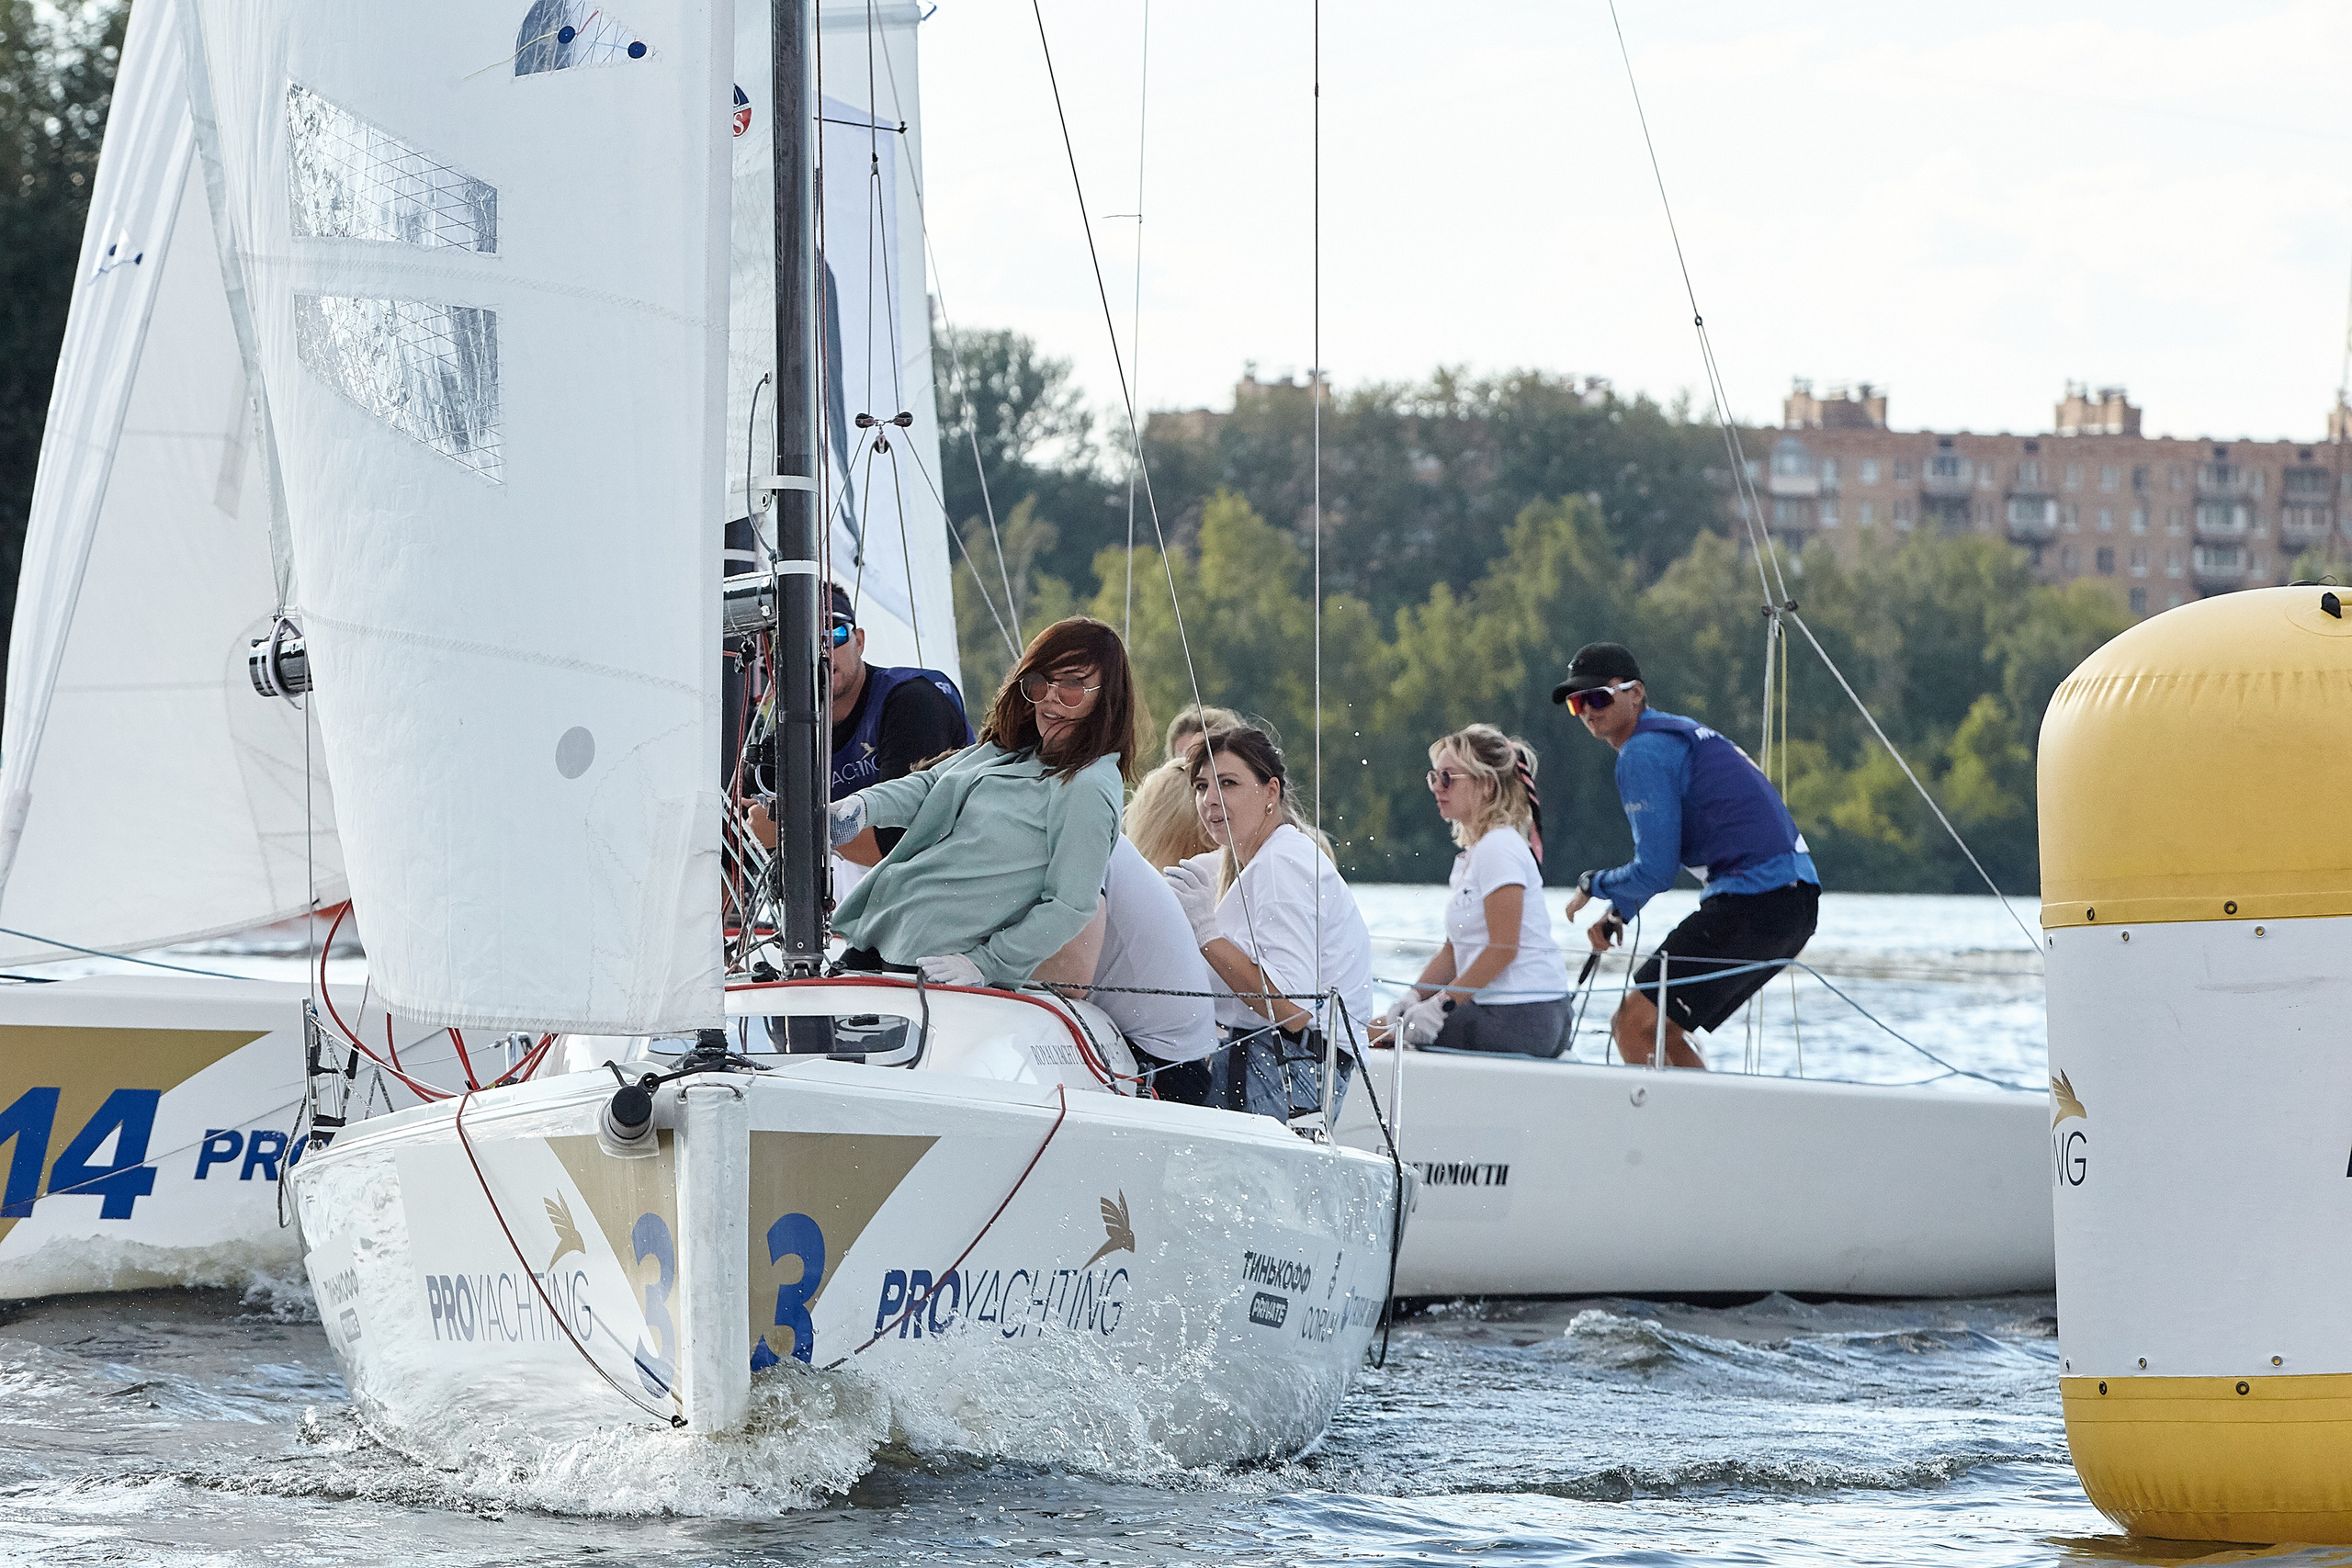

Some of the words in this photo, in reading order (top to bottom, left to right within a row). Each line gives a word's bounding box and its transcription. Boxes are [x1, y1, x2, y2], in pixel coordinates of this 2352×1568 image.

[0, 1087, 162, 1220] 14
[425, 1269, 593, 1343] PROYACHTING
[630, 1213, 675, 1399] 3
[751, 1213, 825, 1372] 3
[873, 1268, 1129, 1340] PROYACHTING
[1242, 1250, 1312, 1295] ТИНЬКОФФ
